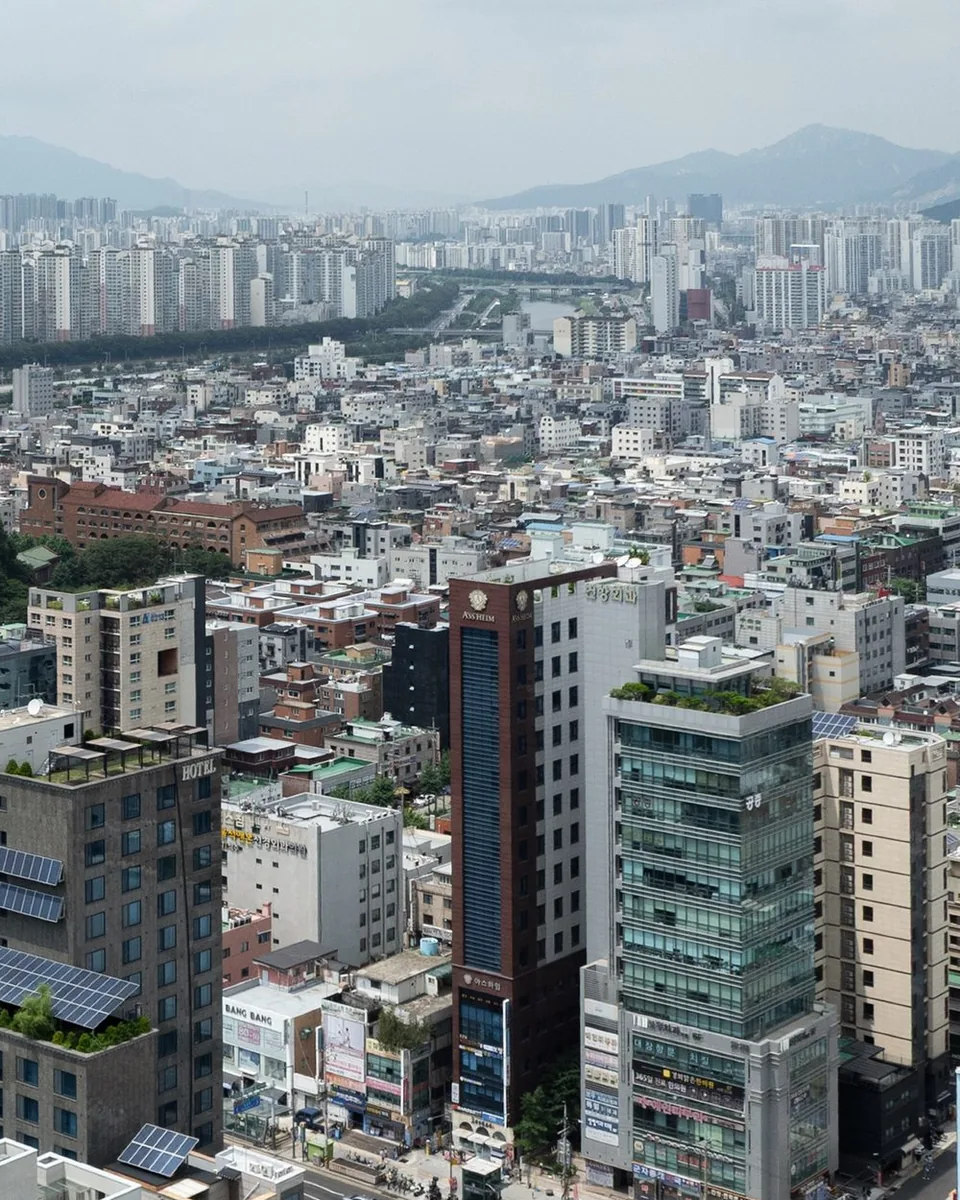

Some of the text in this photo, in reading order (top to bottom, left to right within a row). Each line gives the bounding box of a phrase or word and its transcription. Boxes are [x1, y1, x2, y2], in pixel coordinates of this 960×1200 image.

[182, 759, 217, 782] HOTEL
[225, 1003, 273, 1026] BANG BANG
